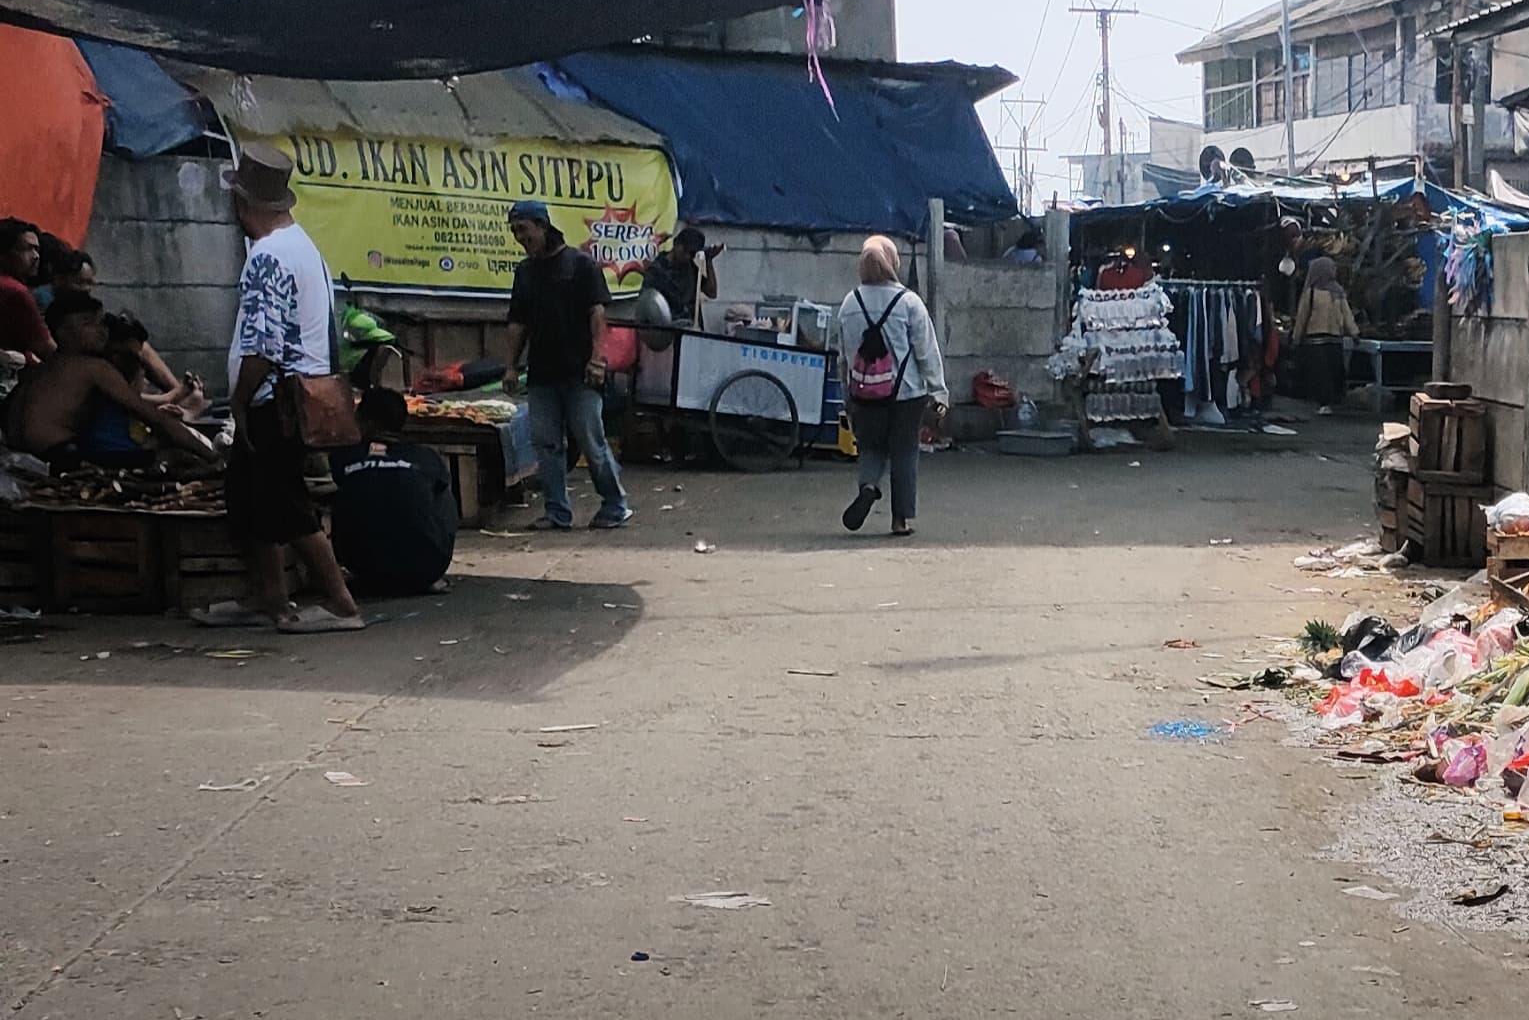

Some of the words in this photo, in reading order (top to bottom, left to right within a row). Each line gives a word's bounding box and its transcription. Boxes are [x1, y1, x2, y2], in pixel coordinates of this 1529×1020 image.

[289, 134, 348, 179] UD.
[354, 137, 431, 186] IKAN
[442, 145, 510, 193] ASIN
[518, 152, 625, 203] SITEPU
[390, 196, 443, 212] MENJUAL
[392, 213, 419, 228] IKAN
[421, 215, 450, 230] ASIN
[592, 243, 658, 262] 10.000
